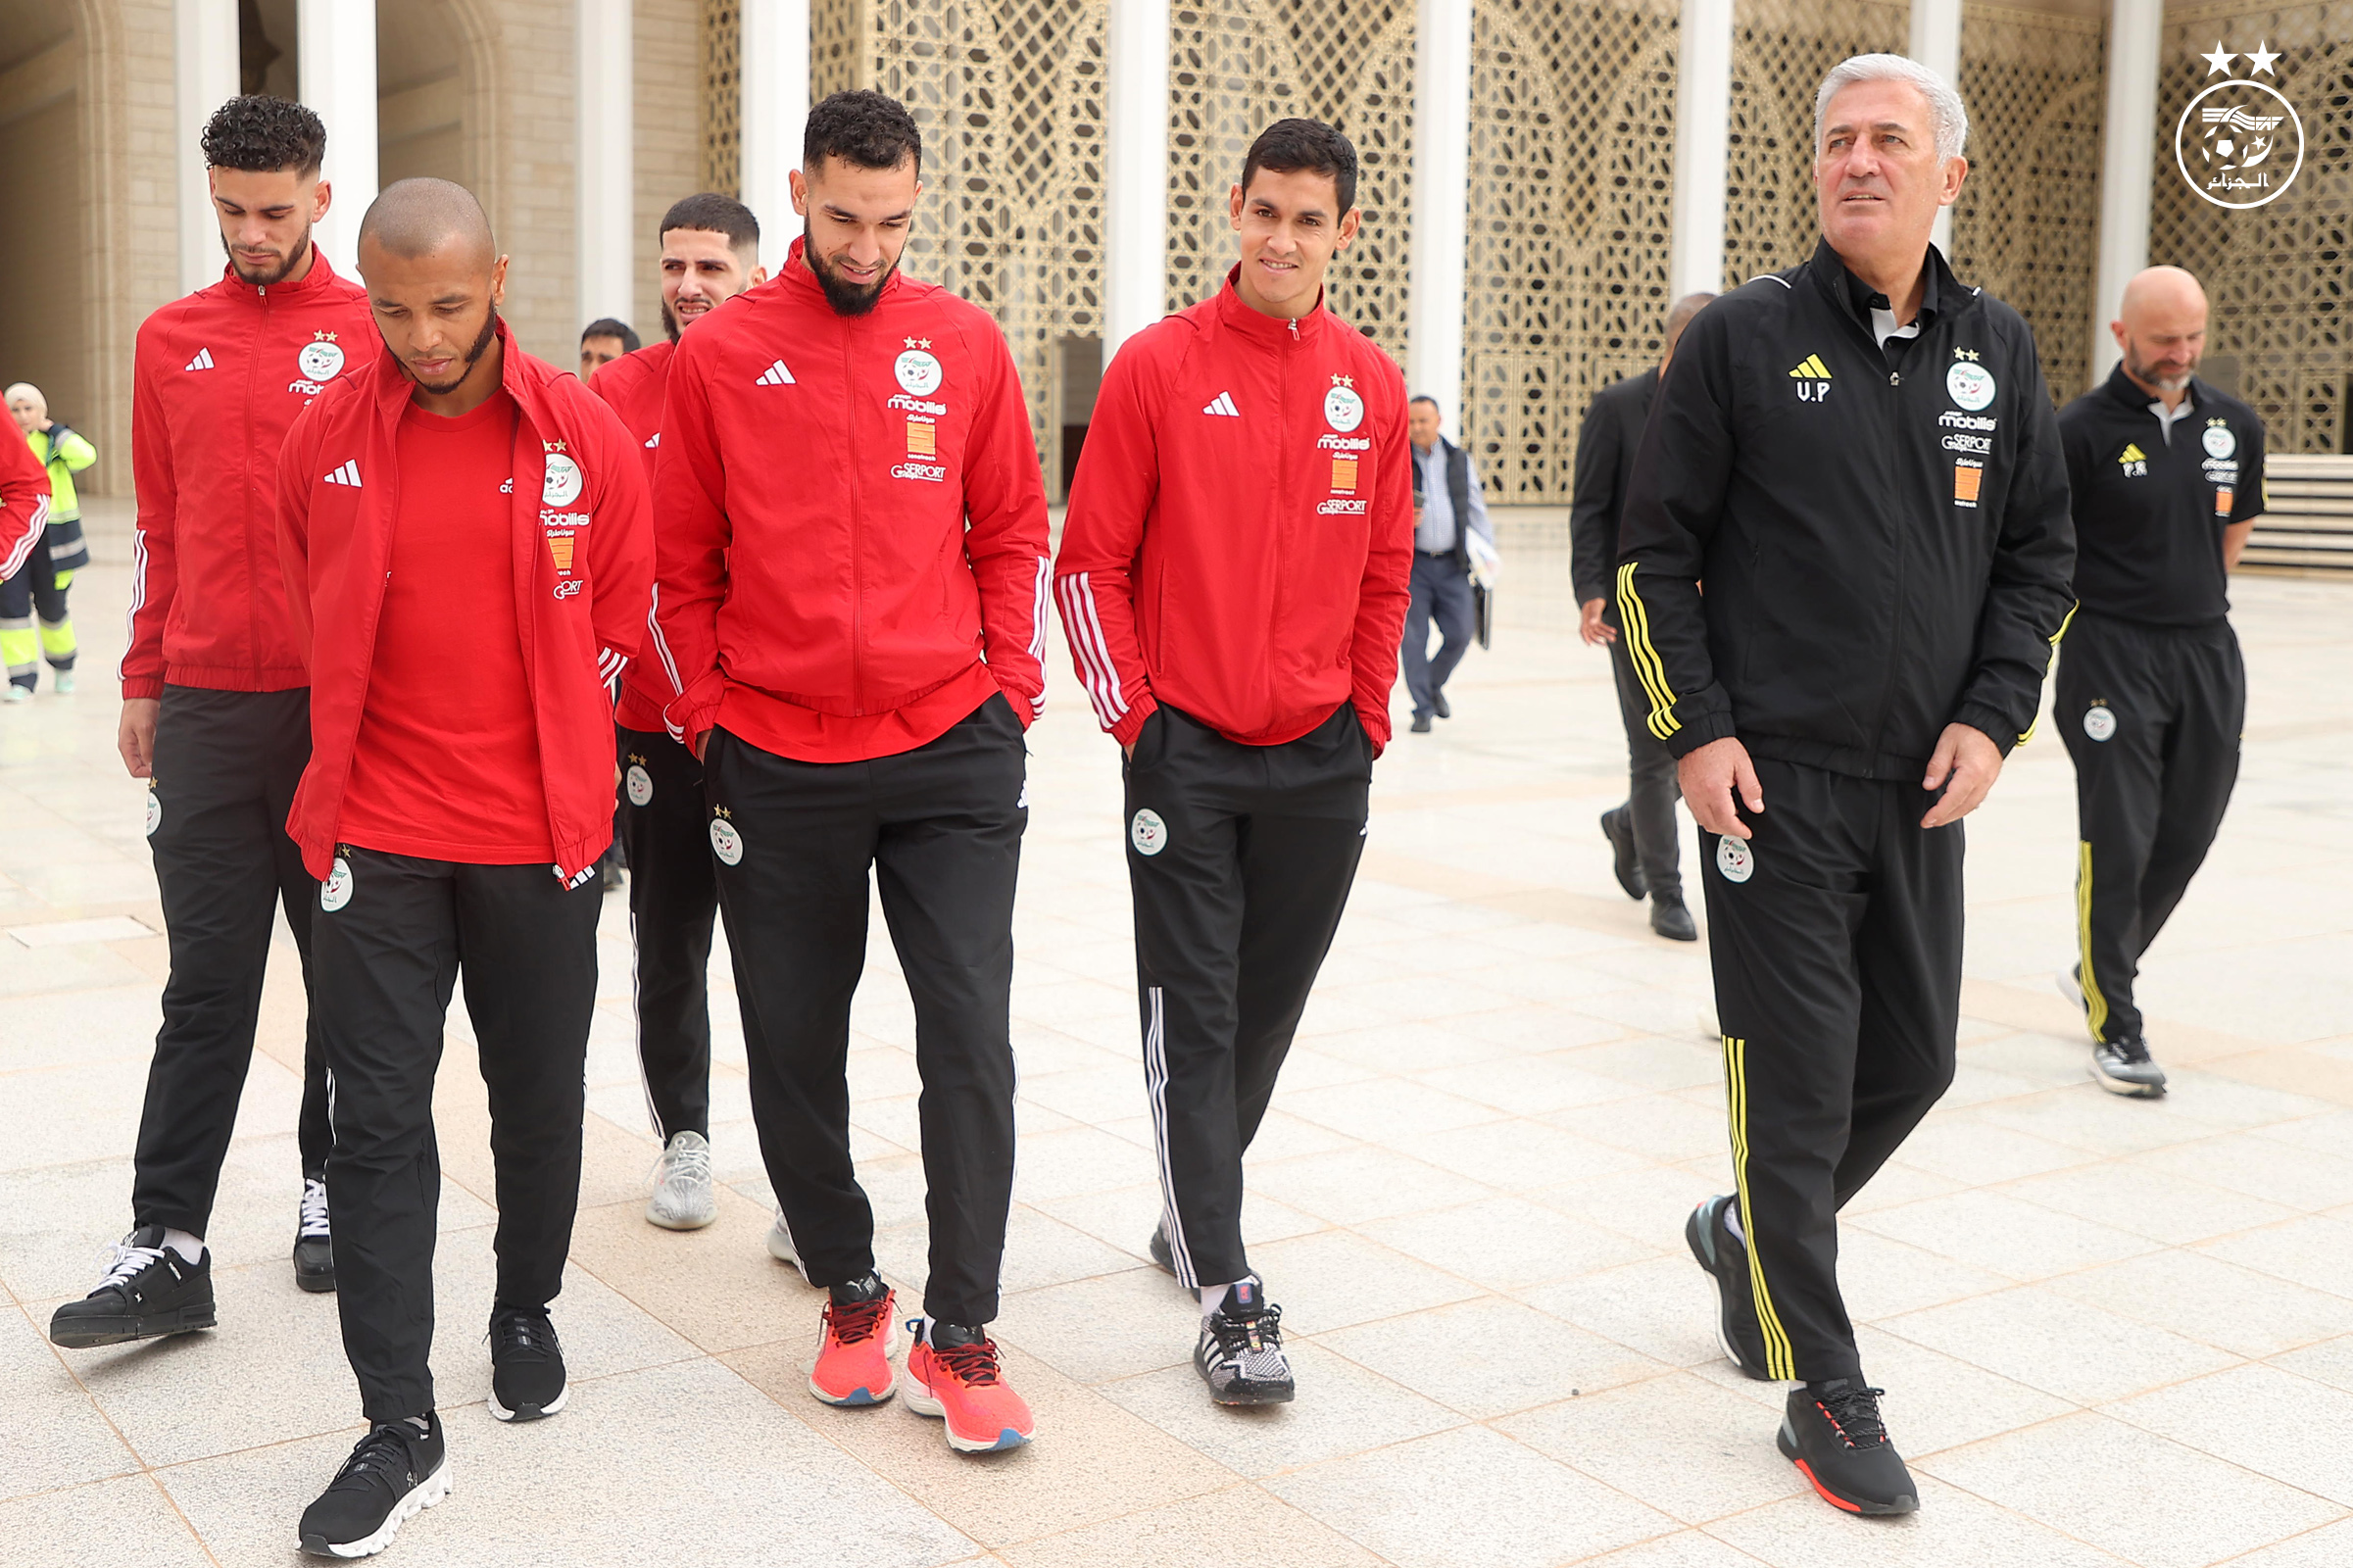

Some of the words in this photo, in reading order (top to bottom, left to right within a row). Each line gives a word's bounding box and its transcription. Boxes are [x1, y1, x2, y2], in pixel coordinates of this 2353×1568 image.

[1796, 381, 1832, 402] U.P
[887, 398, 948, 416] mobilis
[1938, 415, 1996, 431] mobilis
[1316, 437, 1371, 451] mobilis
[903, 463, 947, 479] SERPORT
[1326, 499, 1368, 512] SERPORT
